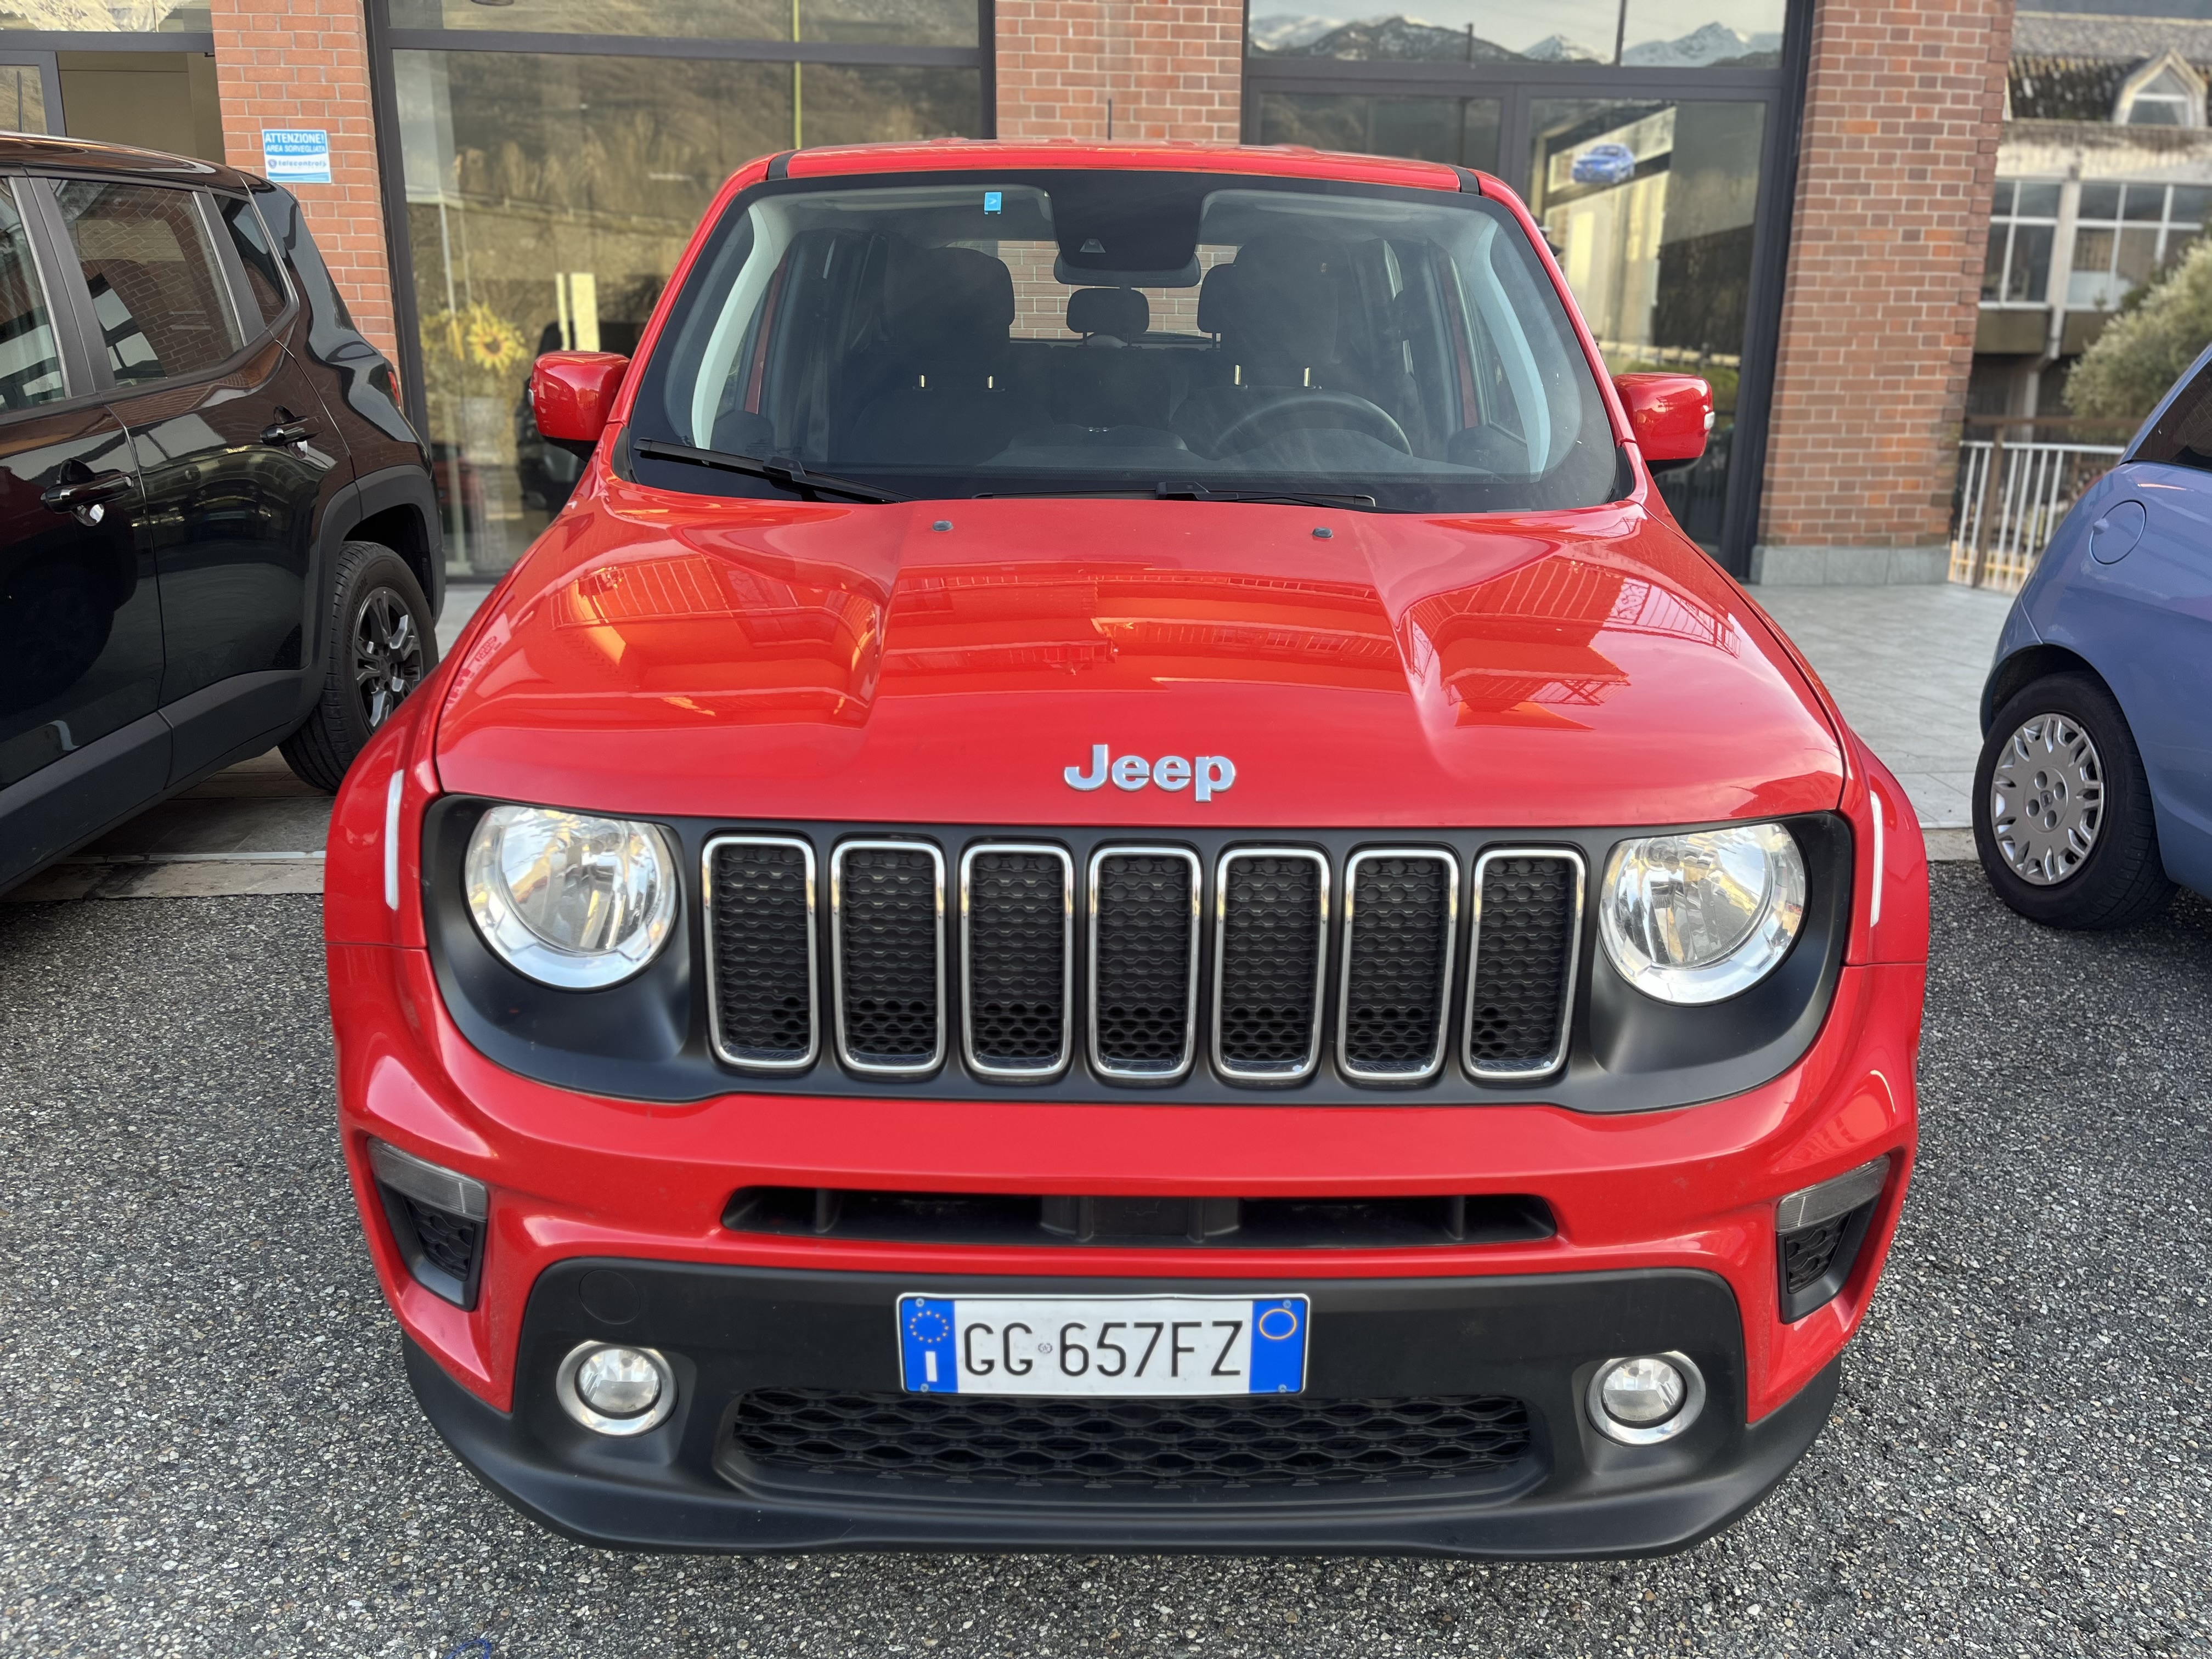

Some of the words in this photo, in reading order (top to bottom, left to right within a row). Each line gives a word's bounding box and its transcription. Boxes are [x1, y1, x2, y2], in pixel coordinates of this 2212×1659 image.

[265, 133, 324, 144] ATTENZIONE!
[1064, 744, 1236, 802] Jeep
[963, 1323, 1033, 1376] GG
[1059, 1321, 1244, 1378] 657FZ
